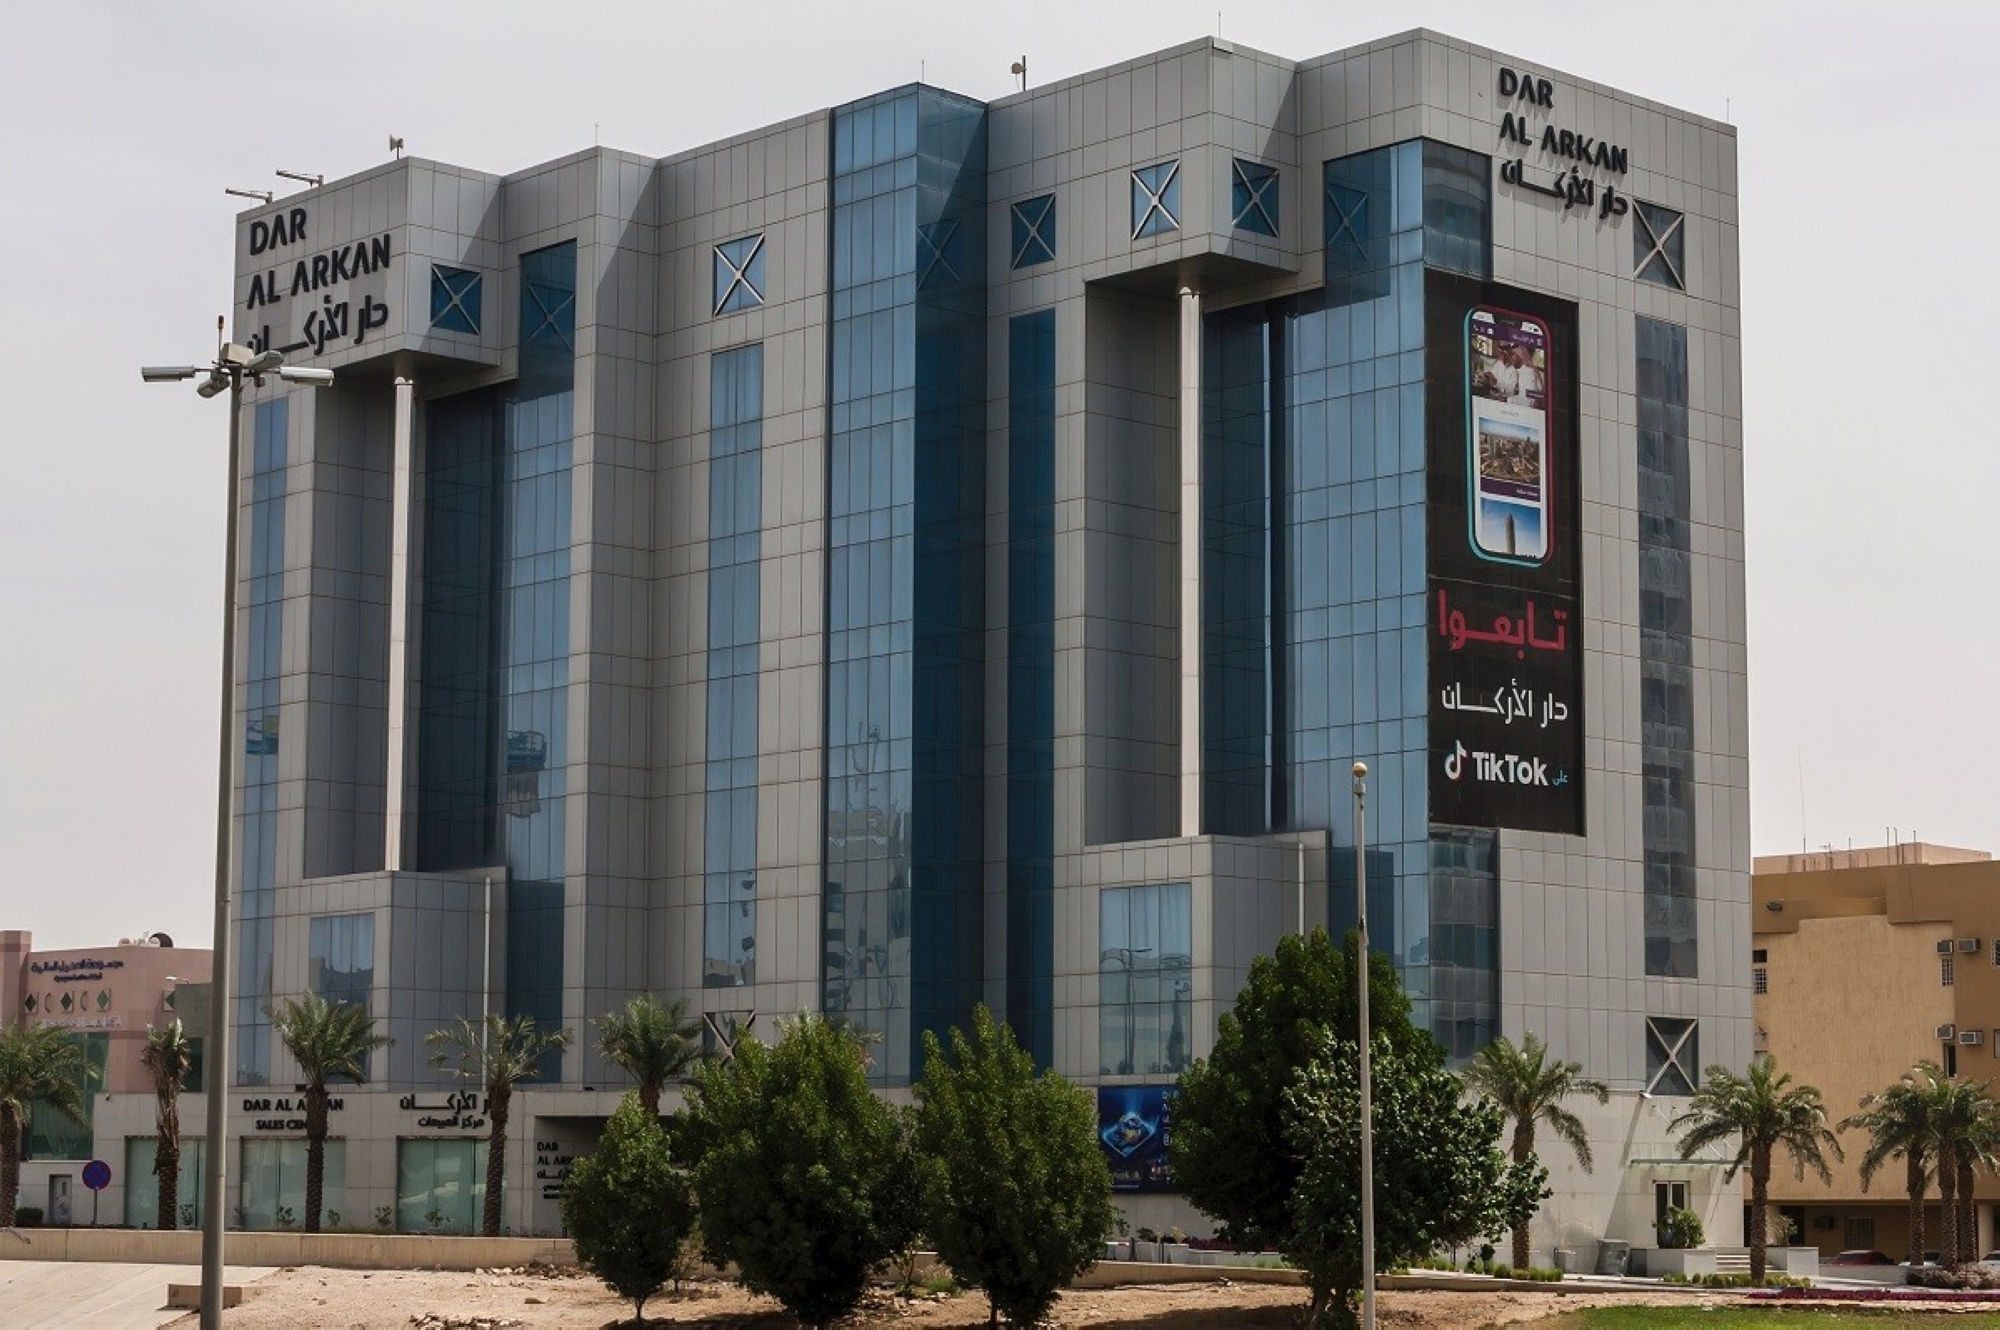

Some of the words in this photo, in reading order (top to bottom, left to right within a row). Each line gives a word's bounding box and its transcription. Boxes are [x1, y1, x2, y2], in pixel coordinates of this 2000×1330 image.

[1500, 66, 1554, 109] DAR
[1499, 112, 1533, 146] AL
[1541, 125, 1628, 175] ARKAN
[1599, 185, 1629, 220] دار
[250, 208, 307, 256] DAR
[246, 269, 281, 310] AL
[290, 233, 391, 297] ARKAN
[353, 294, 390, 345] دار
[1437, 588, 1568, 661] تابعوا
[1540, 692, 1569, 728] دار
[1472, 750, 1549, 787] TikTok
[243, 1098, 271, 1111] DAR
[275, 1098, 292, 1111] AL
[296, 1098, 344, 1111] AAN
[255, 1119, 285, 1130] SALES
